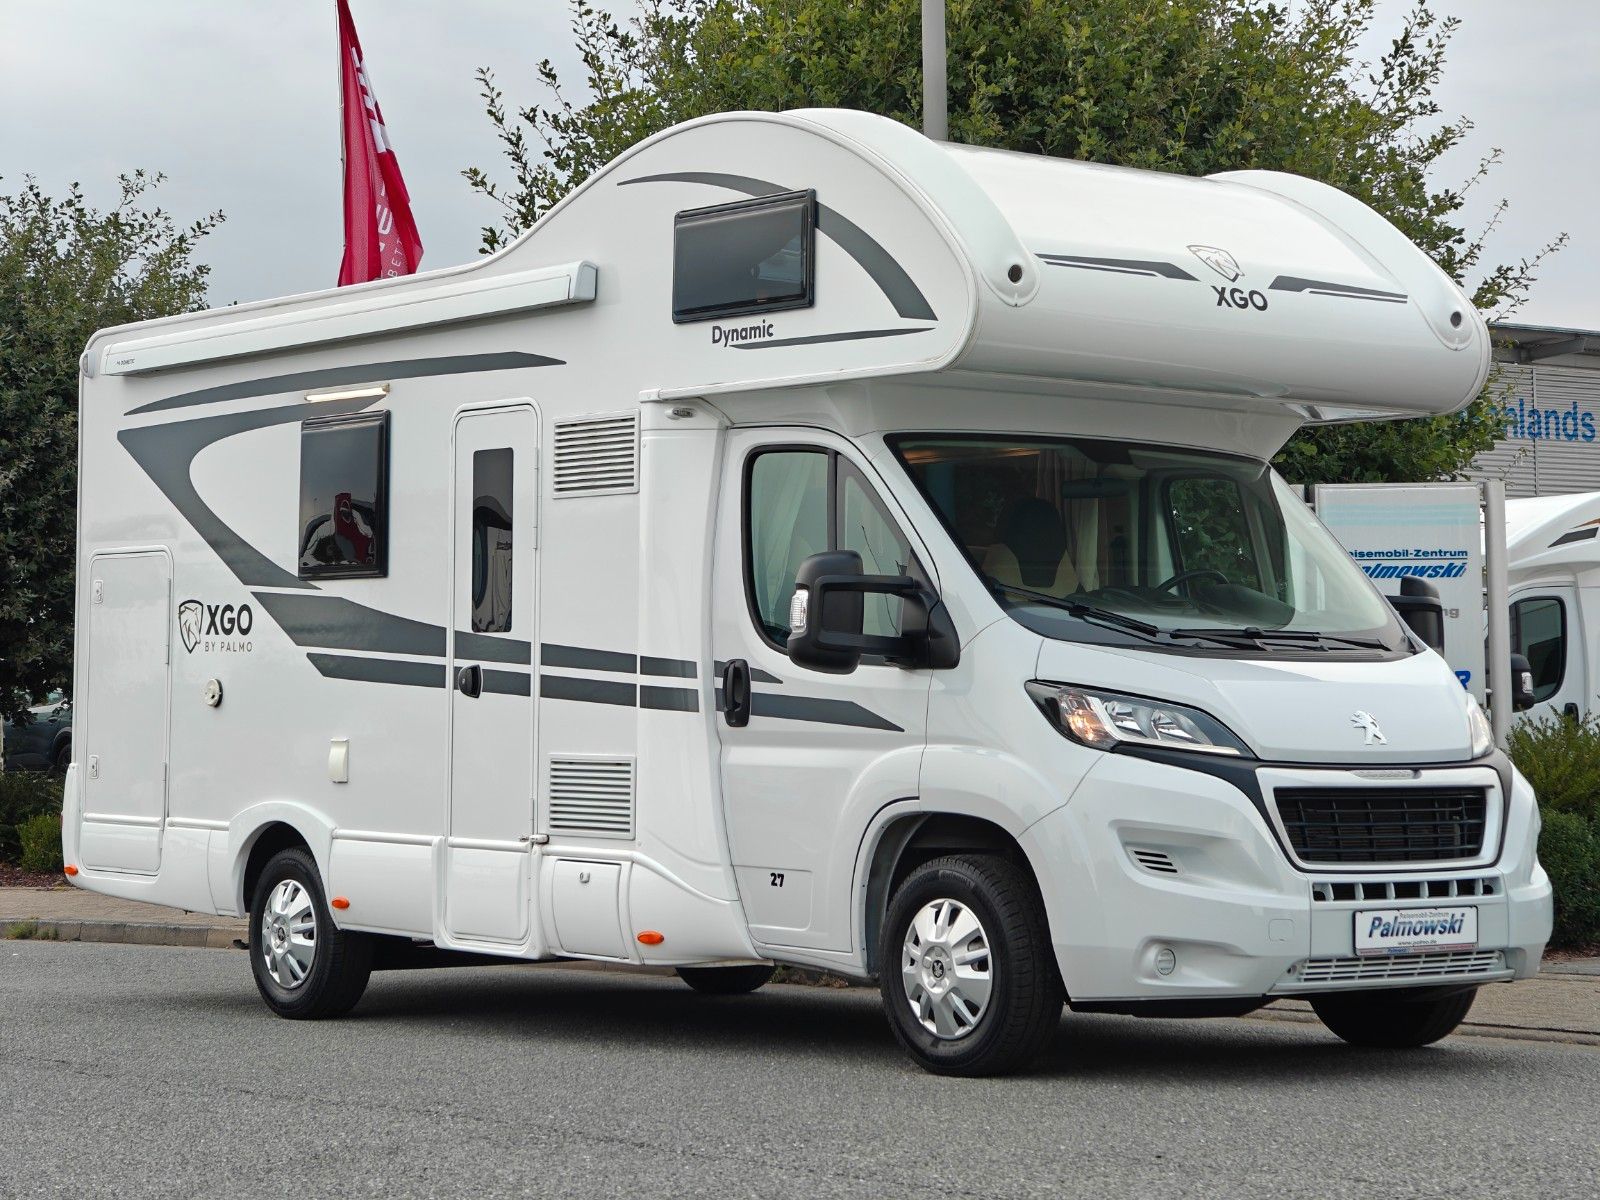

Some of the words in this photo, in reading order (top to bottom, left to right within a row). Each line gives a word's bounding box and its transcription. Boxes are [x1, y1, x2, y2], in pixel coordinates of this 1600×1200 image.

[1210, 285, 1268, 311] XGO
[712, 319, 774, 347] Dynamic
[205, 603, 253, 636] XGO
[204, 641, 217, 652] BY
[220, 641, 253, 652] PALMO
[770, 872, 785, 888] 27
[1368, 913, 1466, 938] Palmowski
